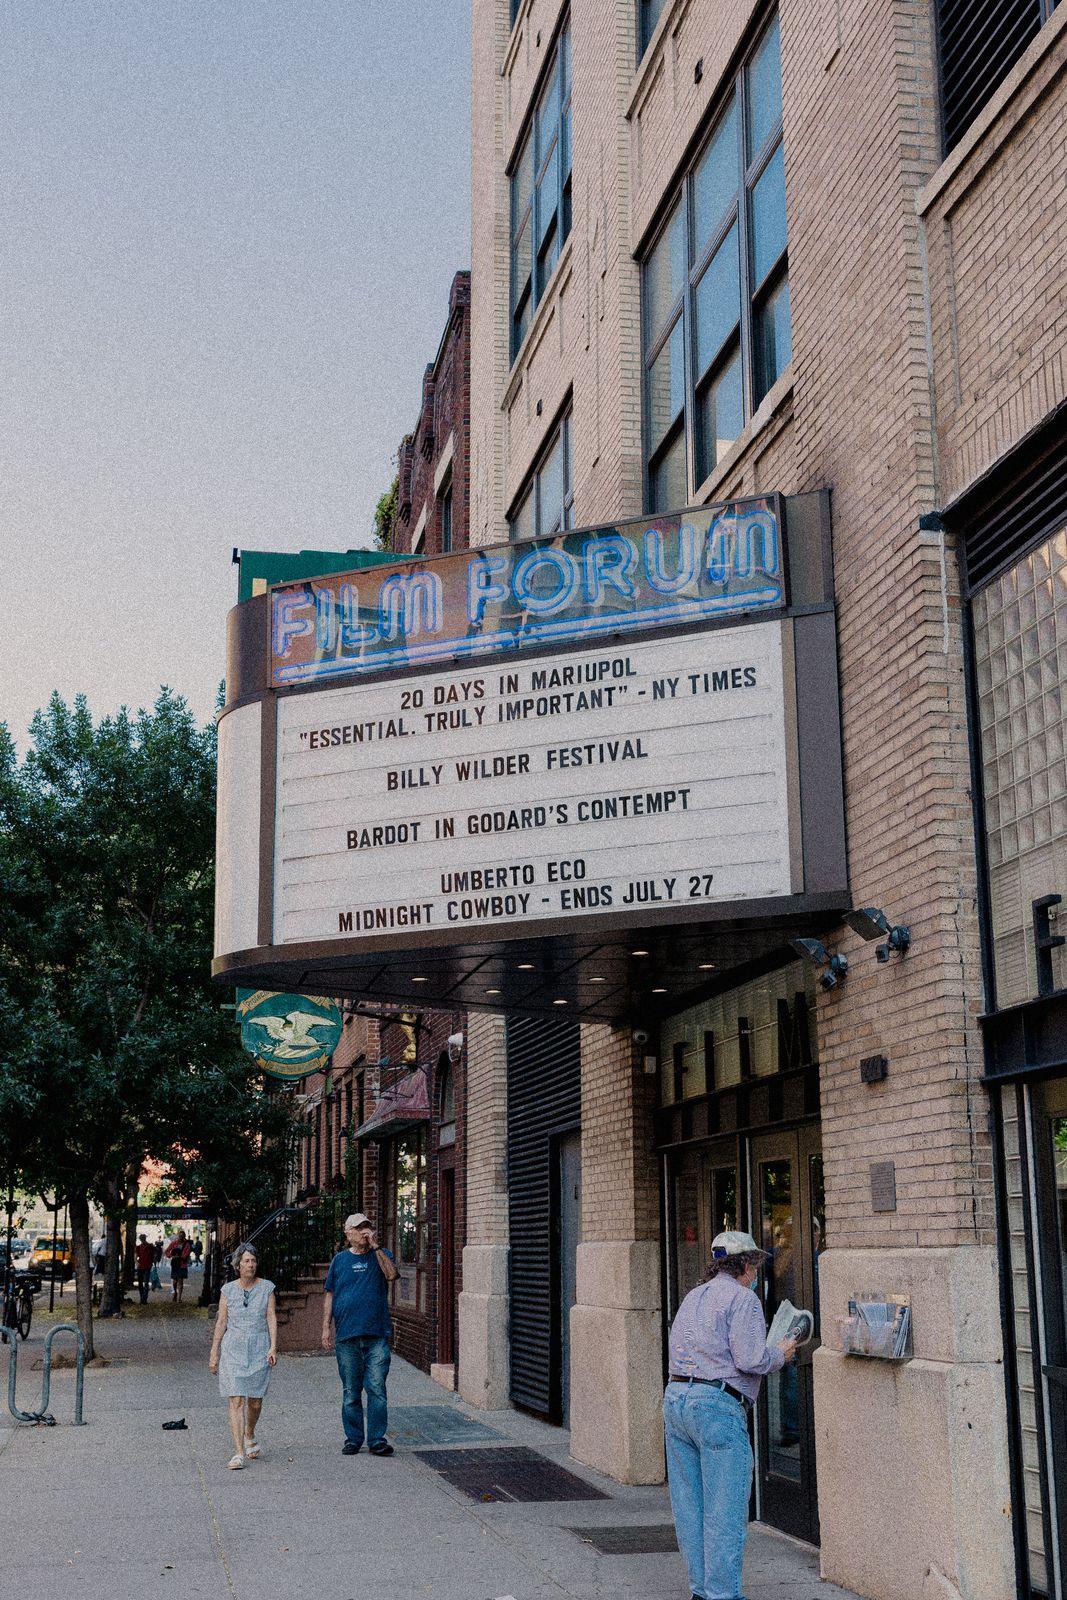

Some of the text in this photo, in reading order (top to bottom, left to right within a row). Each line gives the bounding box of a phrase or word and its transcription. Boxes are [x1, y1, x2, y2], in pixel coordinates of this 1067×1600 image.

[272, 508, 779, 659] FILM FORUM
[400, 657, 637, 710] 20 DAYS IN MARIUPOL
[424, 705, 486, 732] TRULY
[652, 677, 680, 700] NY
[687, 666, 757, 695] TIMES
[387, 738, 648, 791] BILLY WILDER FESTIVAL
[346, 788, 691, 849] BARDOT IN GODARD'S CONTEMPT
[338, 903, 434, 932] MIDNIGHT
[447, 893, 530, 921] COWBOY
[560, 885, 613, 910] ENDS
[622, 877, 677, 904] JULY
[689, 874, 714, 897] 27
[441, 858, 586, 894] UMBERTO ECO
